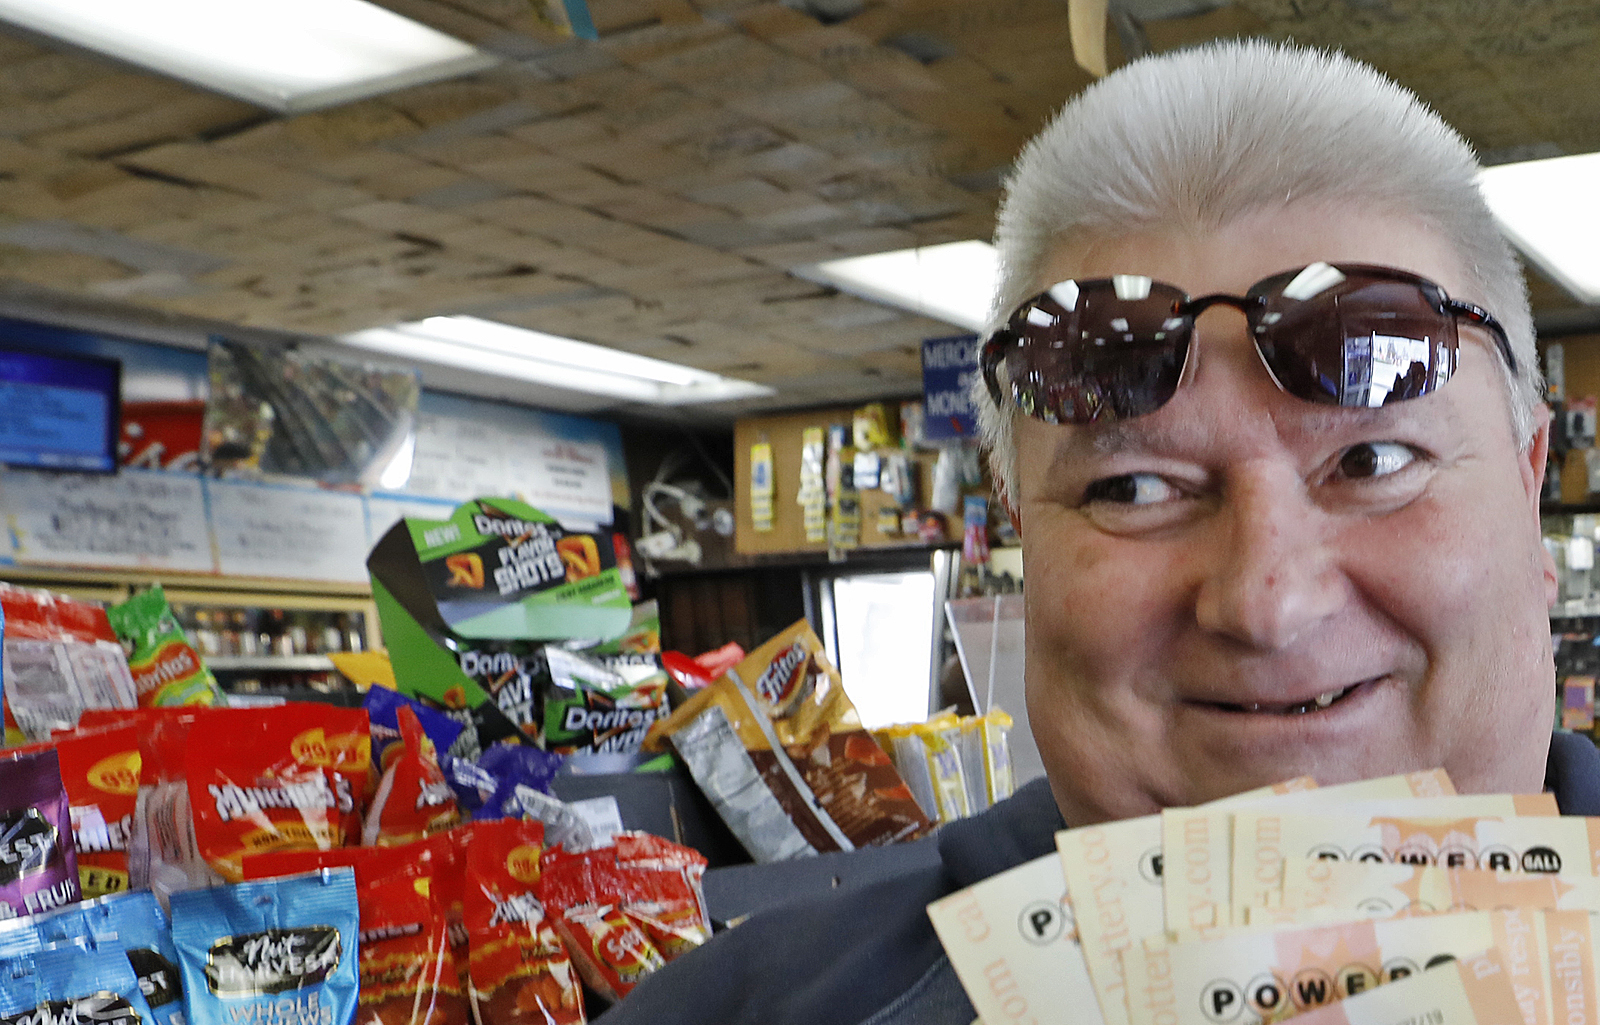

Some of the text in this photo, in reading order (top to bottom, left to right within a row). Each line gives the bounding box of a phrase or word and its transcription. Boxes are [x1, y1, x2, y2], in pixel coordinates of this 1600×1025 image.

[494, 551, 565, 596] SHOTS
[756, 642, 806, 705] Fritos
[243, 933, 306, 965] Nut
[229, 991, 319, 1022] WHOLE
